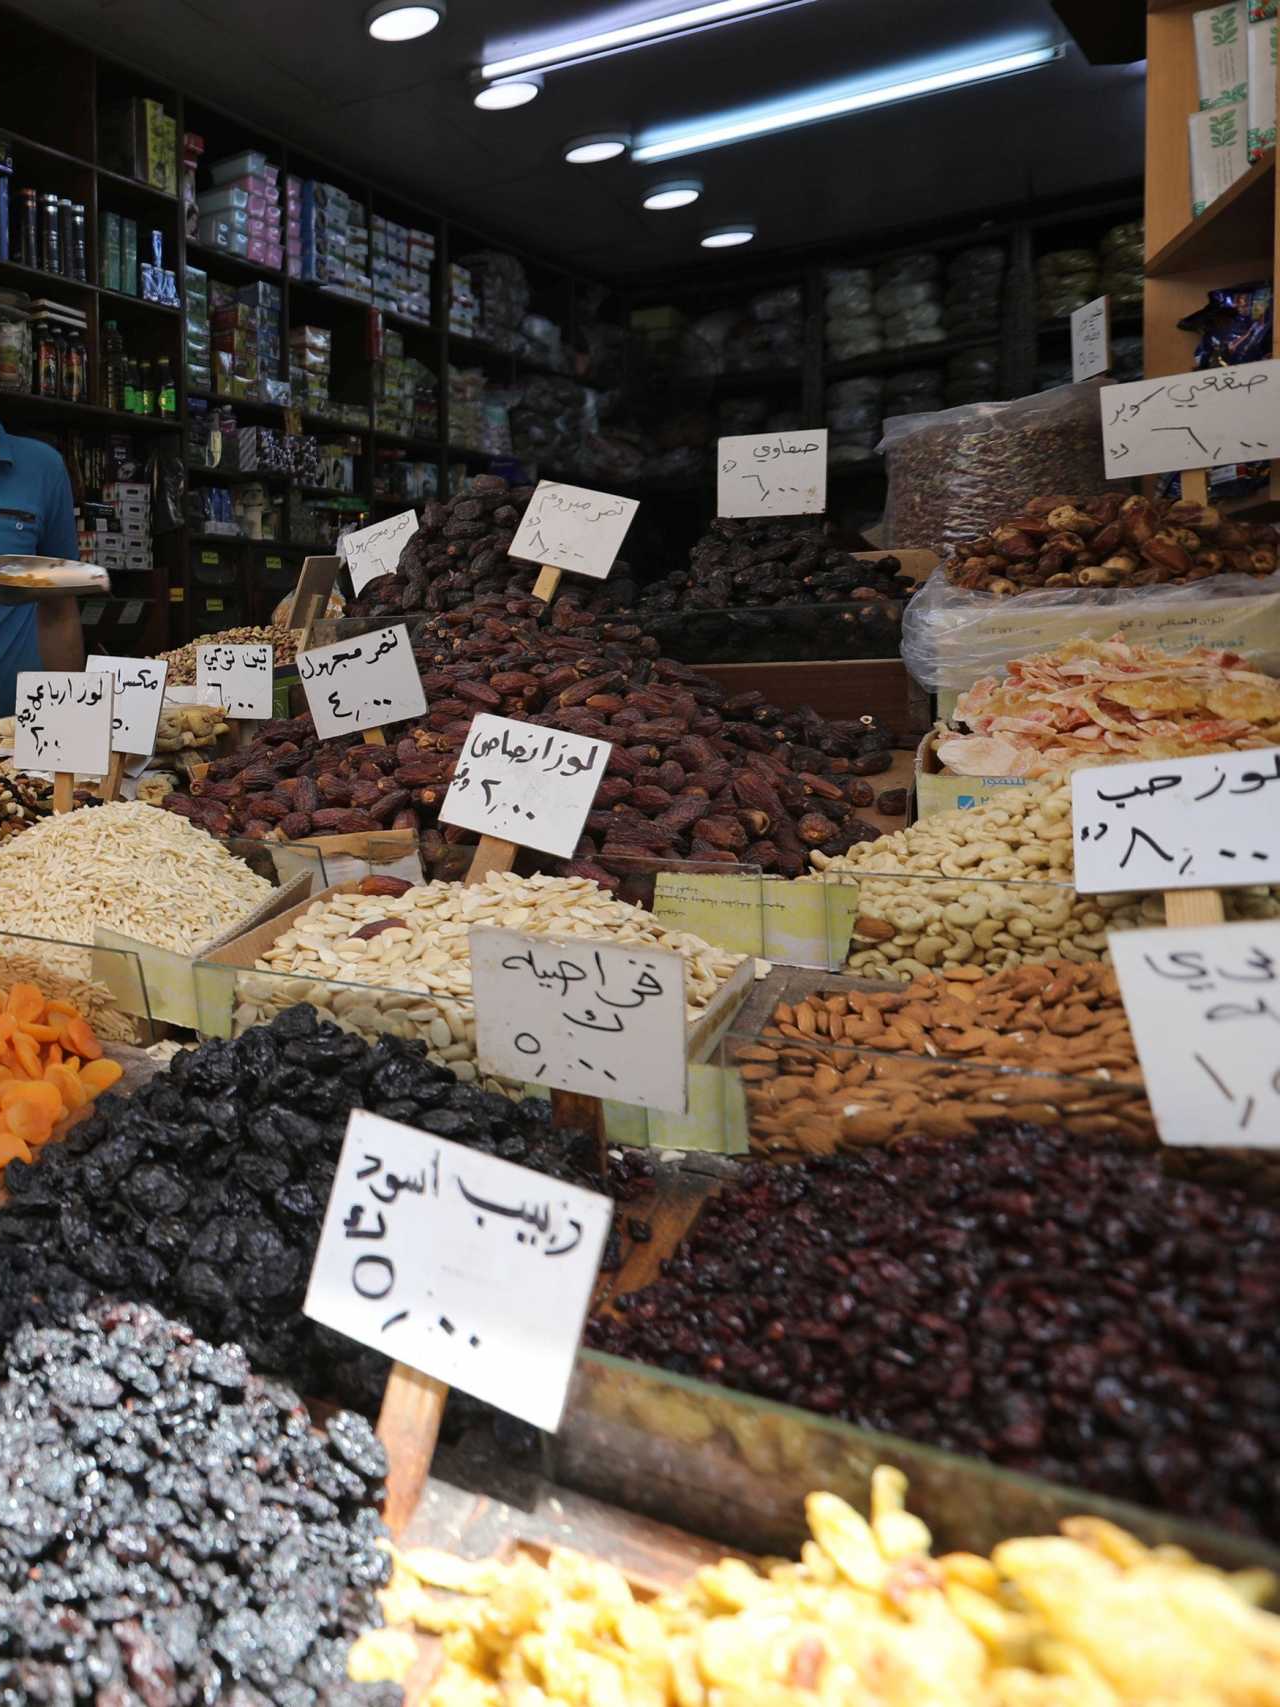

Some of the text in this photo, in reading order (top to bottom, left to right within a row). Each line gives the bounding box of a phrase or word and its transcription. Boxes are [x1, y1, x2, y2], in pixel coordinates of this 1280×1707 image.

[242, 648, 267, 671] تين
[301, 629, 398, 679] تمر مجهول
[77, 677, 103, 706] لوز
[543, 744, 598, 777] لوز
[1097, 774, 1182, 808] حب
[456, 1173, 582, 1256] زبيب
